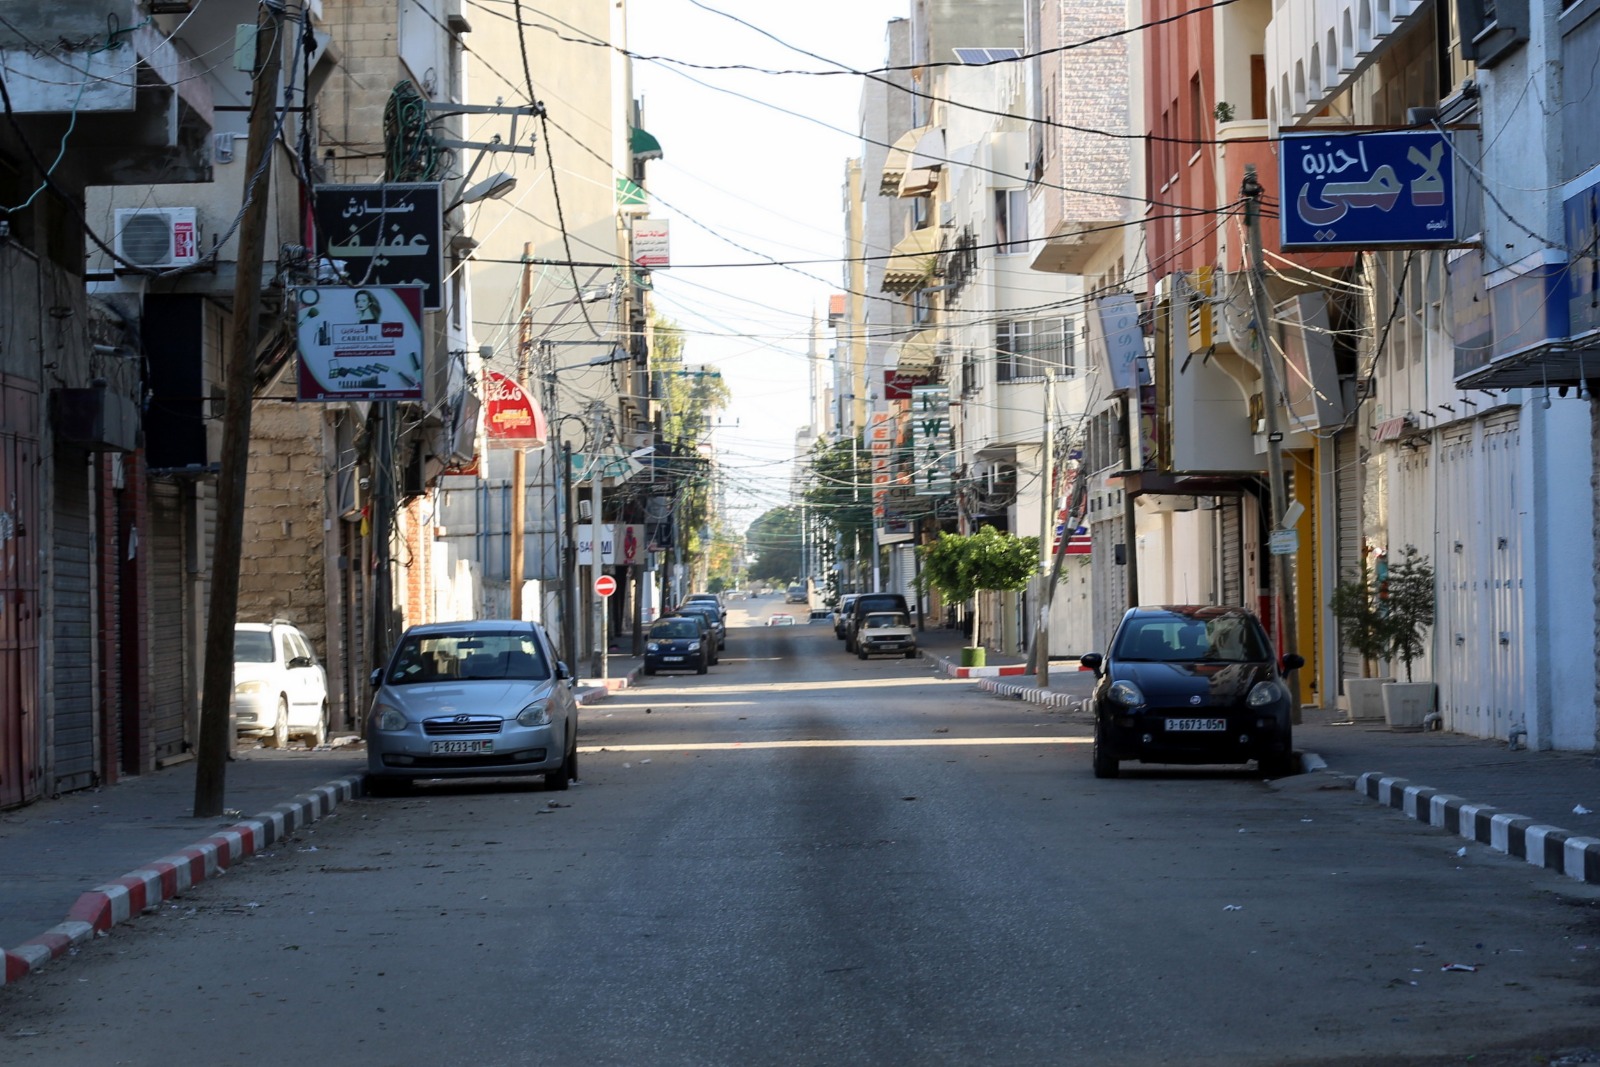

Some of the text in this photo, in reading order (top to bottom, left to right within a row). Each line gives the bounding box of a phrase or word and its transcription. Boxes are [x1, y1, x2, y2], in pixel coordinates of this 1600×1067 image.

[1301, 141, 1369, 180] احذية
[342, 197, 415, 218] مفارش
[328, 223, 430, 266] عفيف
